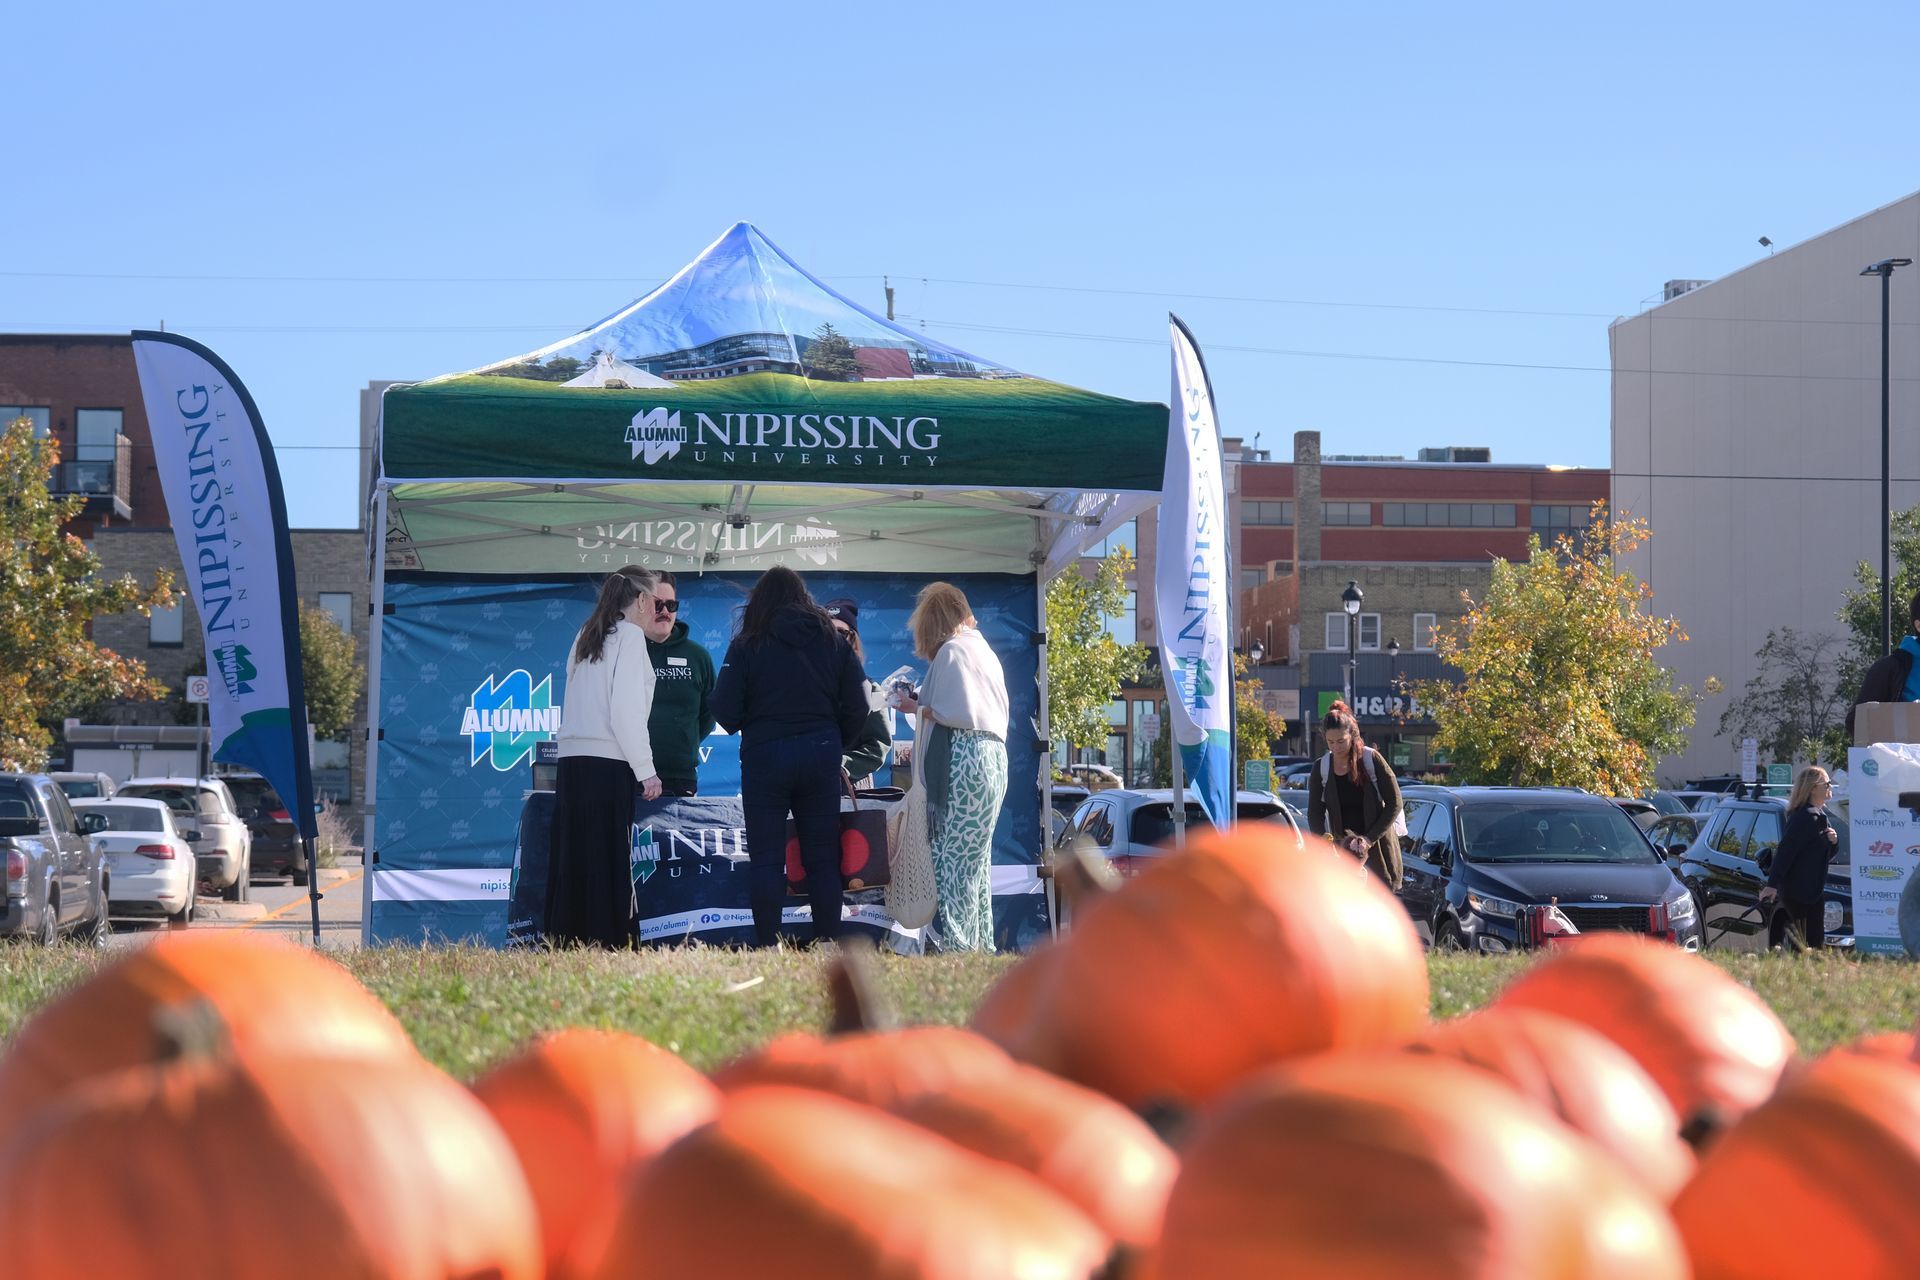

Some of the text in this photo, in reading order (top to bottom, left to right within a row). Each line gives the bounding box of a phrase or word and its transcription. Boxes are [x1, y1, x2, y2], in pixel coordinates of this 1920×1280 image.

[625, 427, 687, 443] ALUMNI
[694, 412, 941, 450] NIPISSING
[694, 450, 938, 467] UNIVERSITY
[177, 383, 236, 637] NIPISSING
[213, 383, 250, 630] UNIVERSITY
[220, 640, 240, 702] ALUMNI
[655, 667, 692, 677] ISSING
[1185, 650, 1200, 717] ALUMNI
[463, 708, 560, 733] ALUMNI
